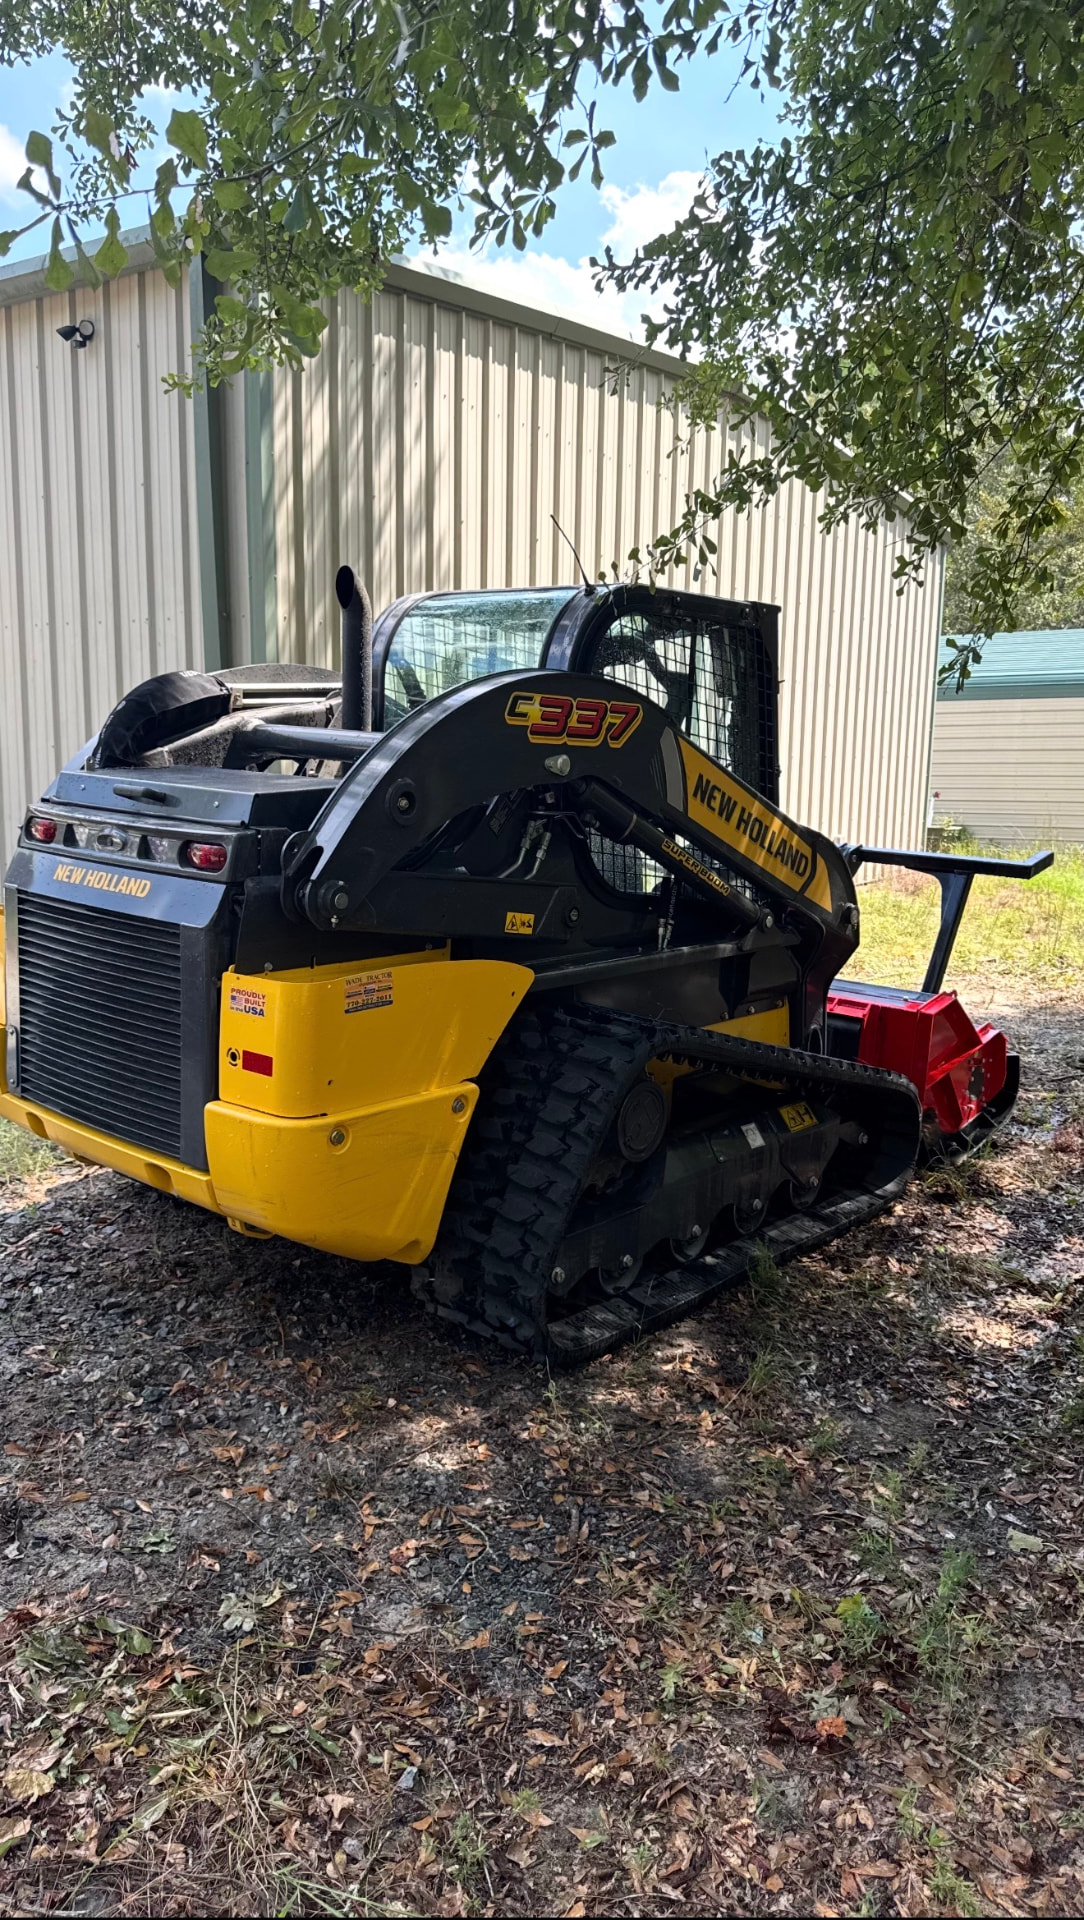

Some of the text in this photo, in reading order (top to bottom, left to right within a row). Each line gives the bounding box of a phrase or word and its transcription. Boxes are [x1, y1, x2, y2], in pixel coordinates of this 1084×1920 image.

[506, 693, 642, 747] C337
[692, 773, 810, 878] NEW HOLLAND
[53, 864, 151, 898] NEW HOLLAND
[366, 971, 392, 981] TRACTOR
[231, 987, 266, 1000] PROUDLY
[244, 998, 266, 1007] BUILT
[244, 1005, 265, 1017] USA
